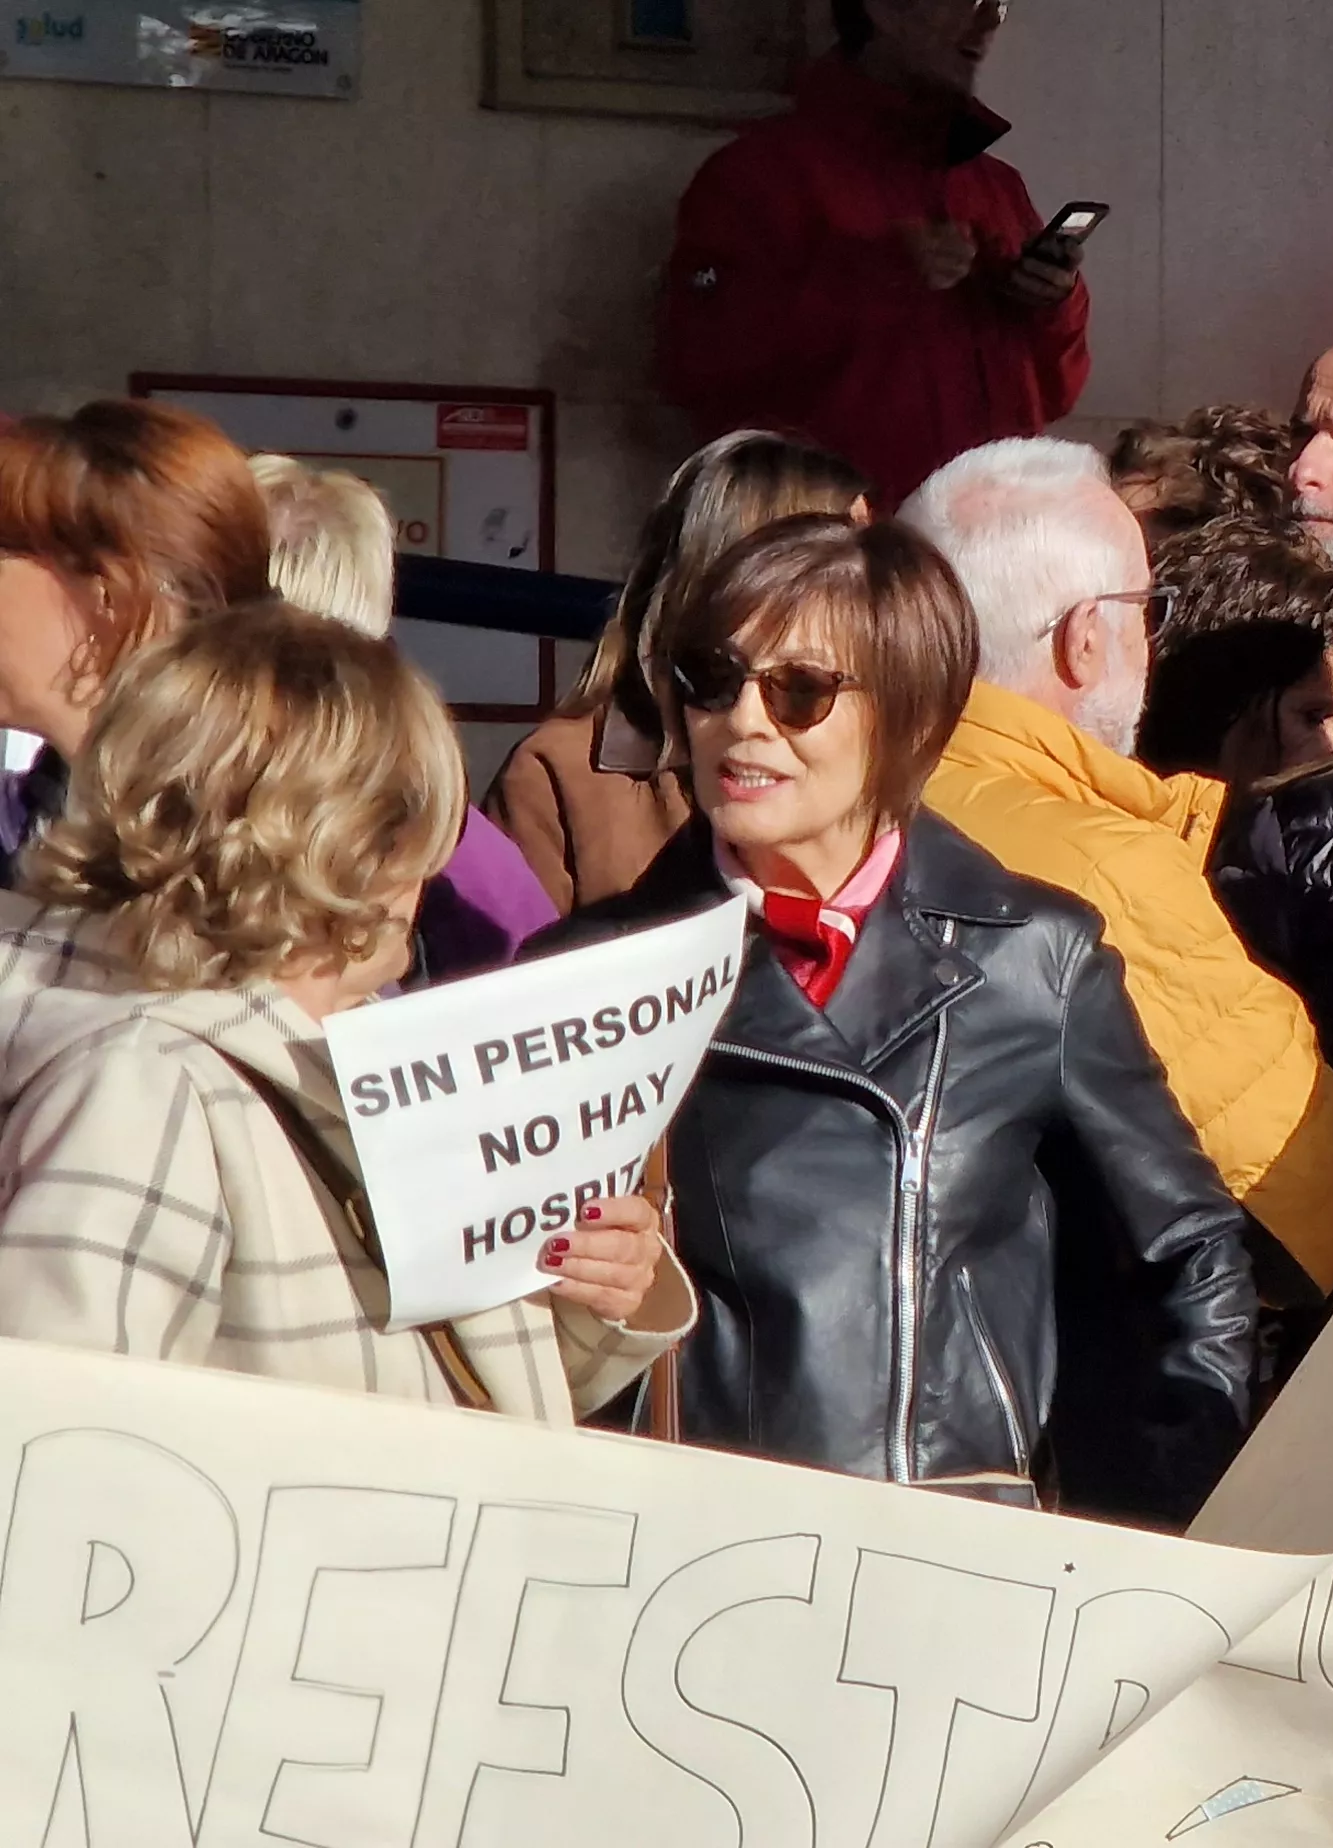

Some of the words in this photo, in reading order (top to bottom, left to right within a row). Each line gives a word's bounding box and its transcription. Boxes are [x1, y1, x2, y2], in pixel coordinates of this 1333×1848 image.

[350, 1052, 459, 1119] SIN
[473, 953, 736, 1086] PERSONAL
[477, 1114, 562, 1175] NO
[578, 1062, 676, 1141] HAY
[461, 1140, 655, 1266] HOSPIT
